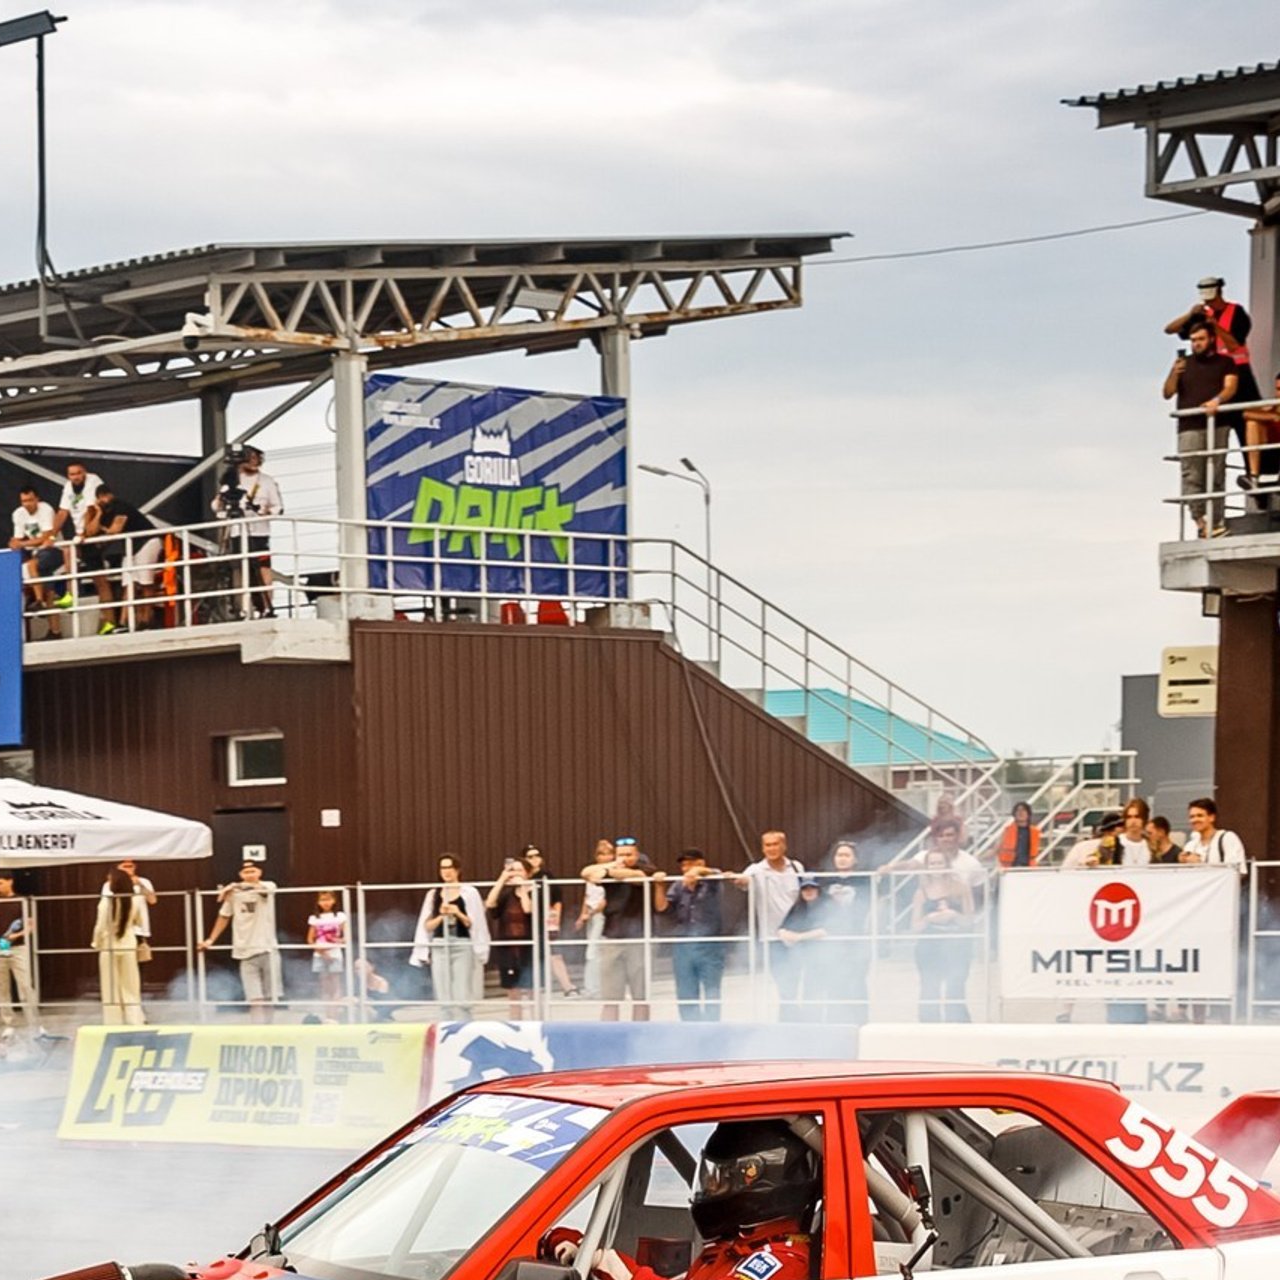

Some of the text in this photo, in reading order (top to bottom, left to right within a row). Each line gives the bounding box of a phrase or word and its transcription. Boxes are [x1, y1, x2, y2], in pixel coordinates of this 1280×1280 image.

[464, 455, 520, 486] GORILLA
[408, 477, 576, 562] DRIFT
[1031, 948, 1200, 974] MITSUJI
[219, 1045, 297, 1075] ШКОЛА
[213, 1078, 302, 1108] ДРИФТА
[1105, 1101, 1259, 1228] 555
